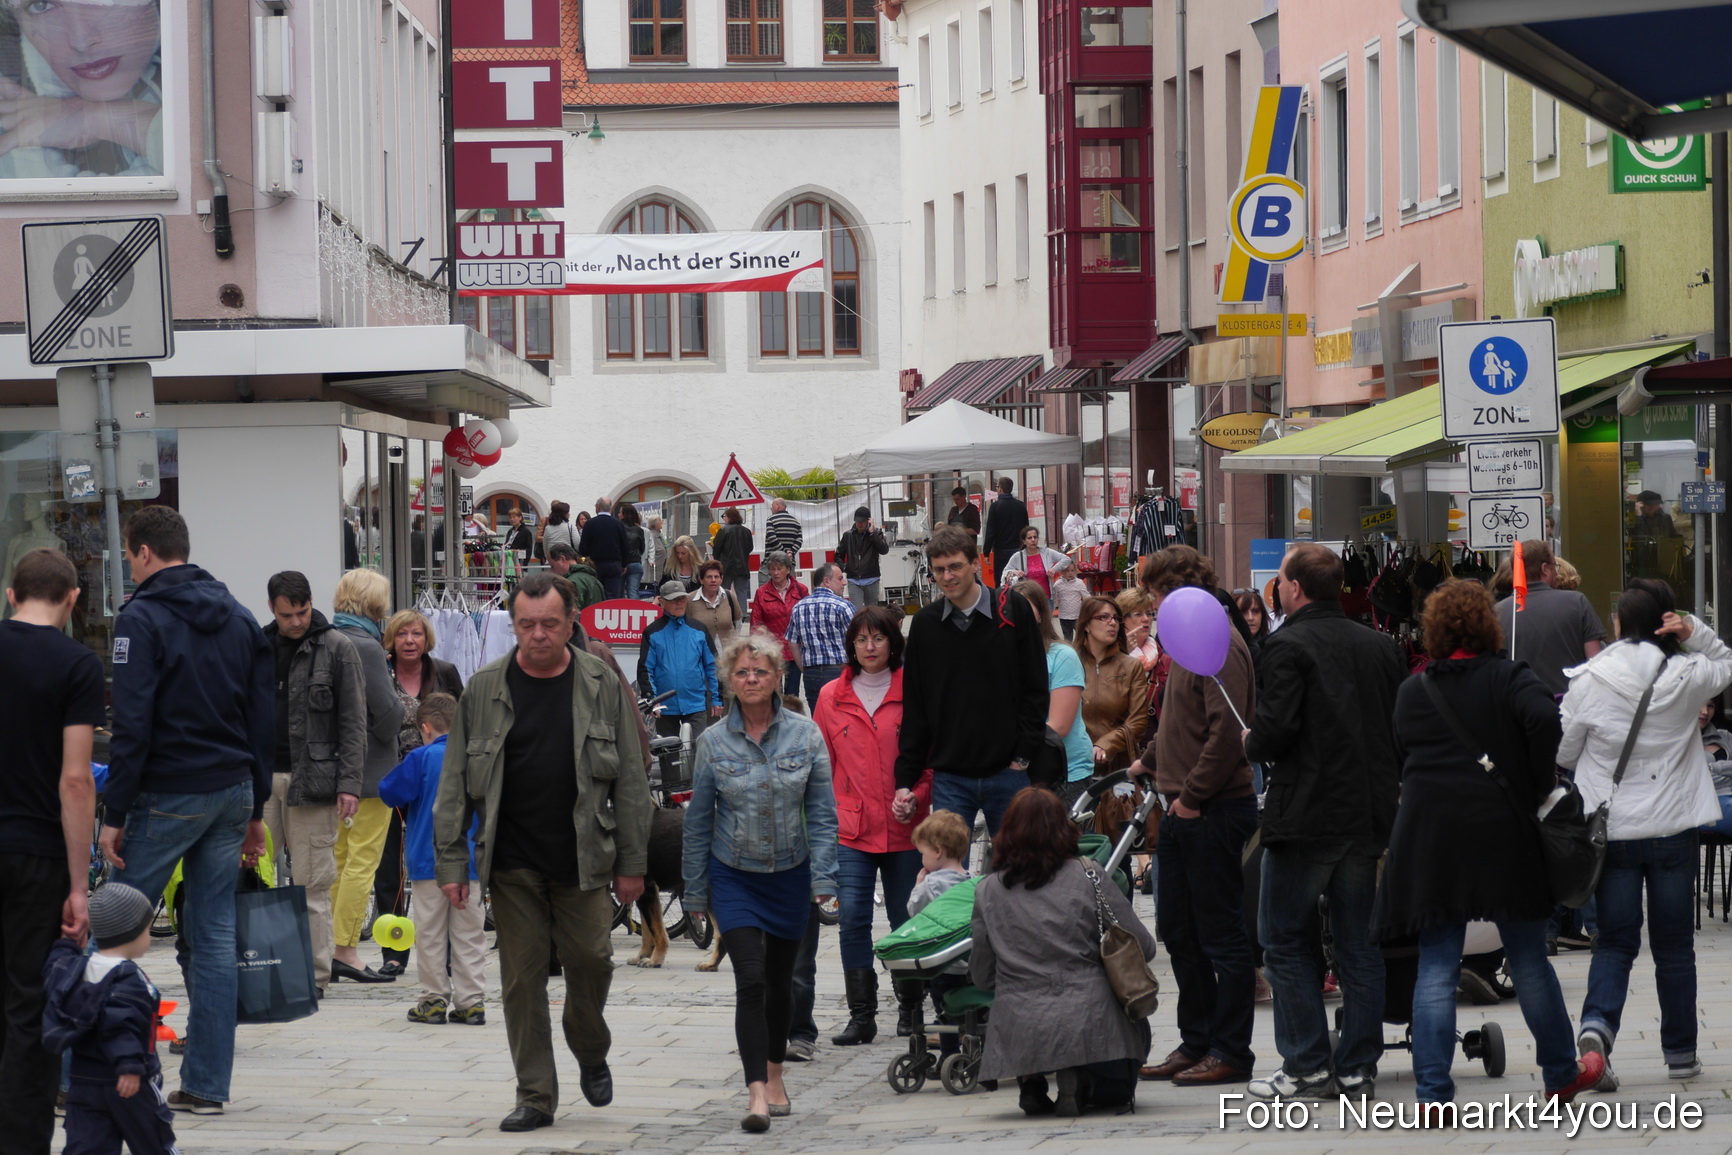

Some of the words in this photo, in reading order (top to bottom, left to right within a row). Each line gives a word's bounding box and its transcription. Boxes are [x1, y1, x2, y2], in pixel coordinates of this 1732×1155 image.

[1624, 174, 1658, 184] QUICK
[1660, 174, 1697, 183] SCHUH
[1251, 196, 1292, 237] B
[460, 224, 560, 257] WITT
[581, 261, 602, 272] der
[687, 252, 724, 270] der
[459, 261, 562, 287] WEIDEN
[1222, 320, 1293, 330] KLOSTERGASE
[1296, 320, 1302, 329] 4
[65, 325, 132, 350] ZONE
[1205, 428, 1221, 437] DIE
[1222, 428, 1262, 437] GOLDSC
[1497, 475, 1516, 486] frei
[1687, 486, 1693, 494] S
[1709, 485, 1715, 493] S
[1494, 531, 1518, 544] frei
[594, 608, 658, 630] WITT
[609, 631, 643, 639] weiden
